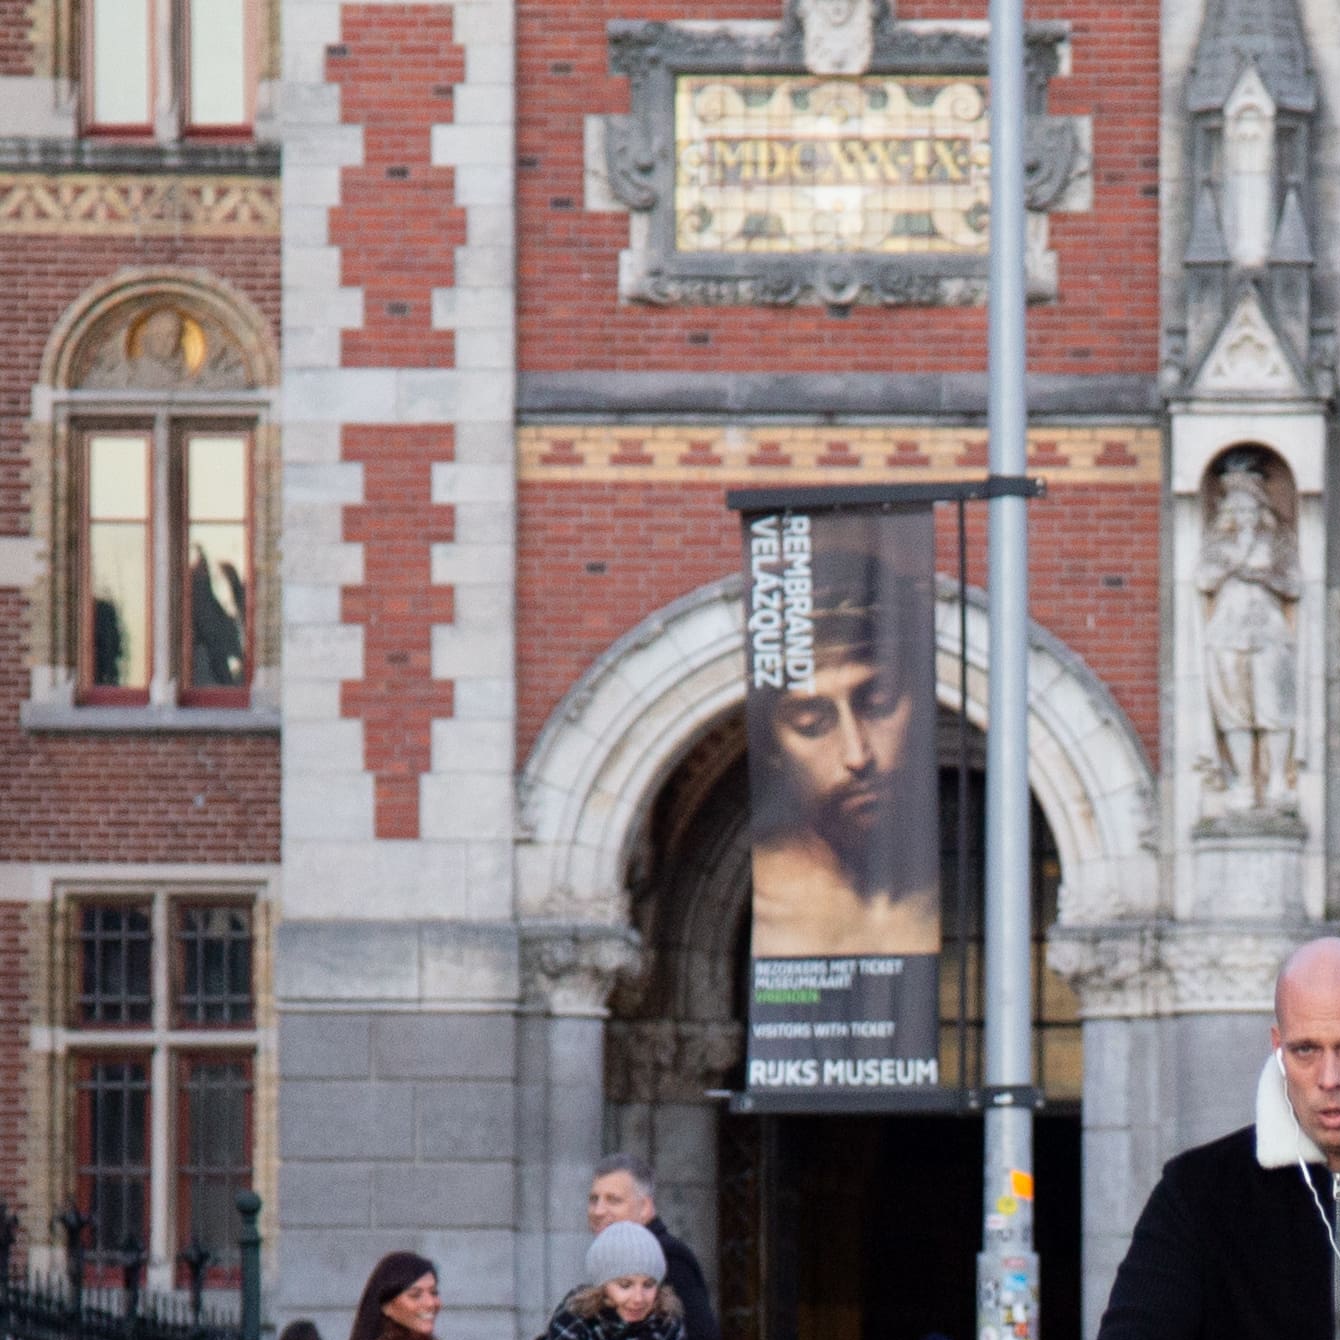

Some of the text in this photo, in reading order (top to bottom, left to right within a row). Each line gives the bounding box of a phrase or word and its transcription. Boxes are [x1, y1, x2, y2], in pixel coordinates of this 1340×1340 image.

[782, 514, 816, 695] REMBRANDT
[858, 958, 905, 976] TICKET
[813, 1022, 849, 1038] WITH
[851, 1020, 896, 1038] TICKET
[823, 1058, 938, 1086] MUSEUM
